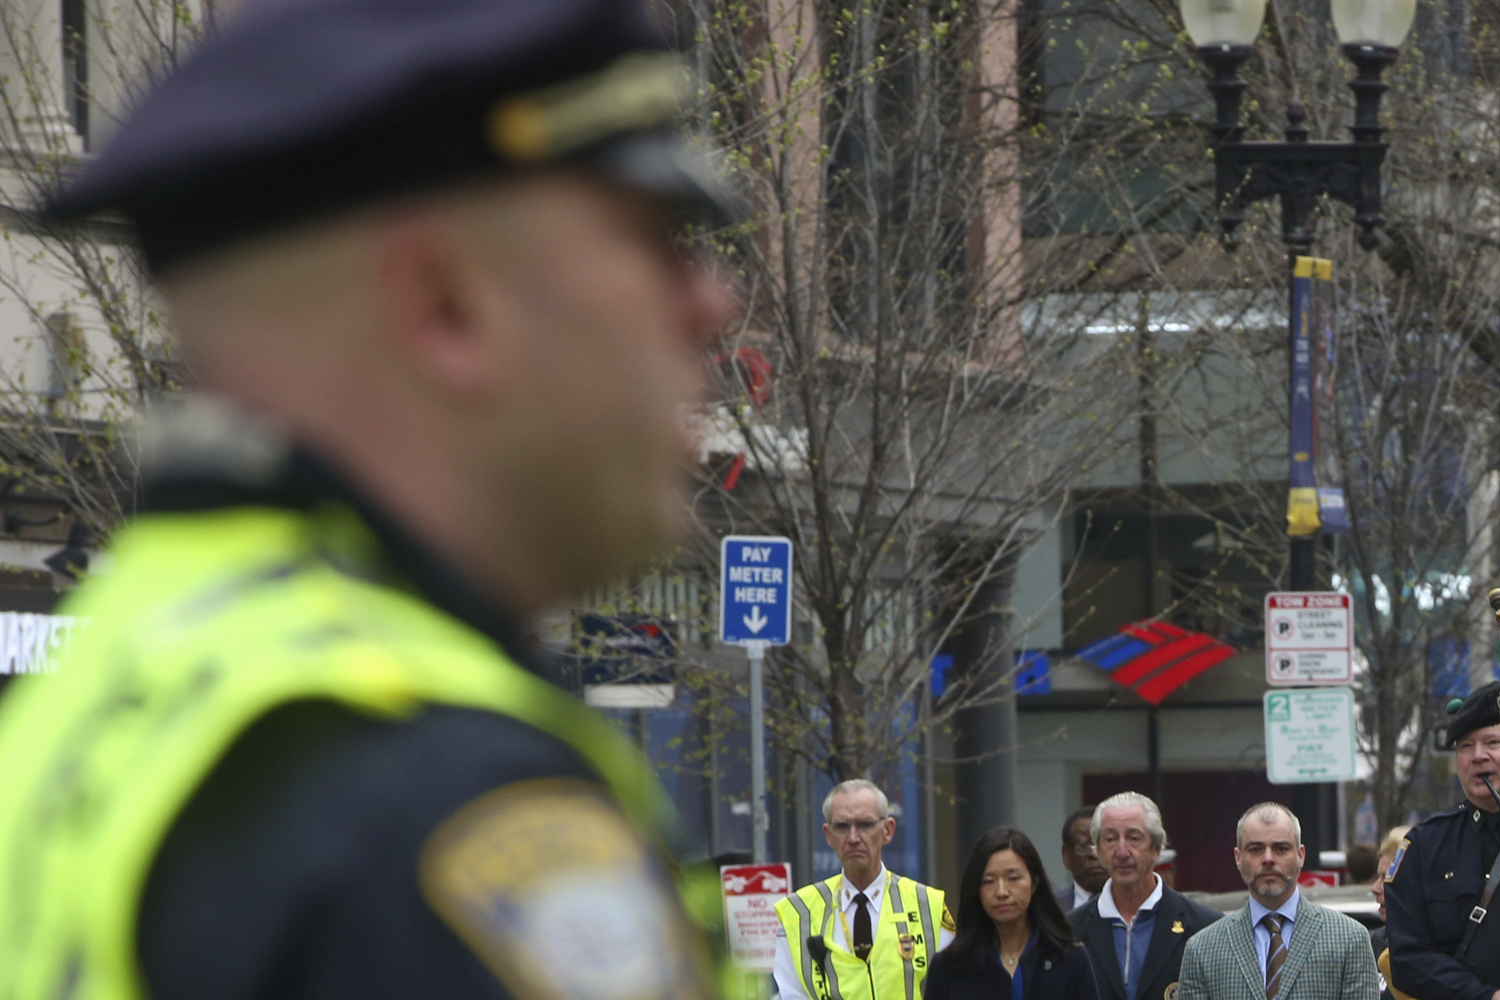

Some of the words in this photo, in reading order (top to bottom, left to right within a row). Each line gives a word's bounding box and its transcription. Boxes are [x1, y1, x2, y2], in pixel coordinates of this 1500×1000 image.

[742, 546, 771, 562] PAY
[729, 566, 783, 583] METER
[735, 587, 777, 604] HERE
[1275, 596, 1303, 607] TOW
[1307, 596, 1342, 607] ZONE
[1298, 610, 1331, 618] STREET
[1298, 619, 1343, 628] CLEANING
[0, 611, 77, 675] ARKET
[1271, 695, 1288, 714] 2
[1297, 743, 1325, 753] PAY
[748, 899, 767, 909] NO
[907, 911, 926, 968] EMS
